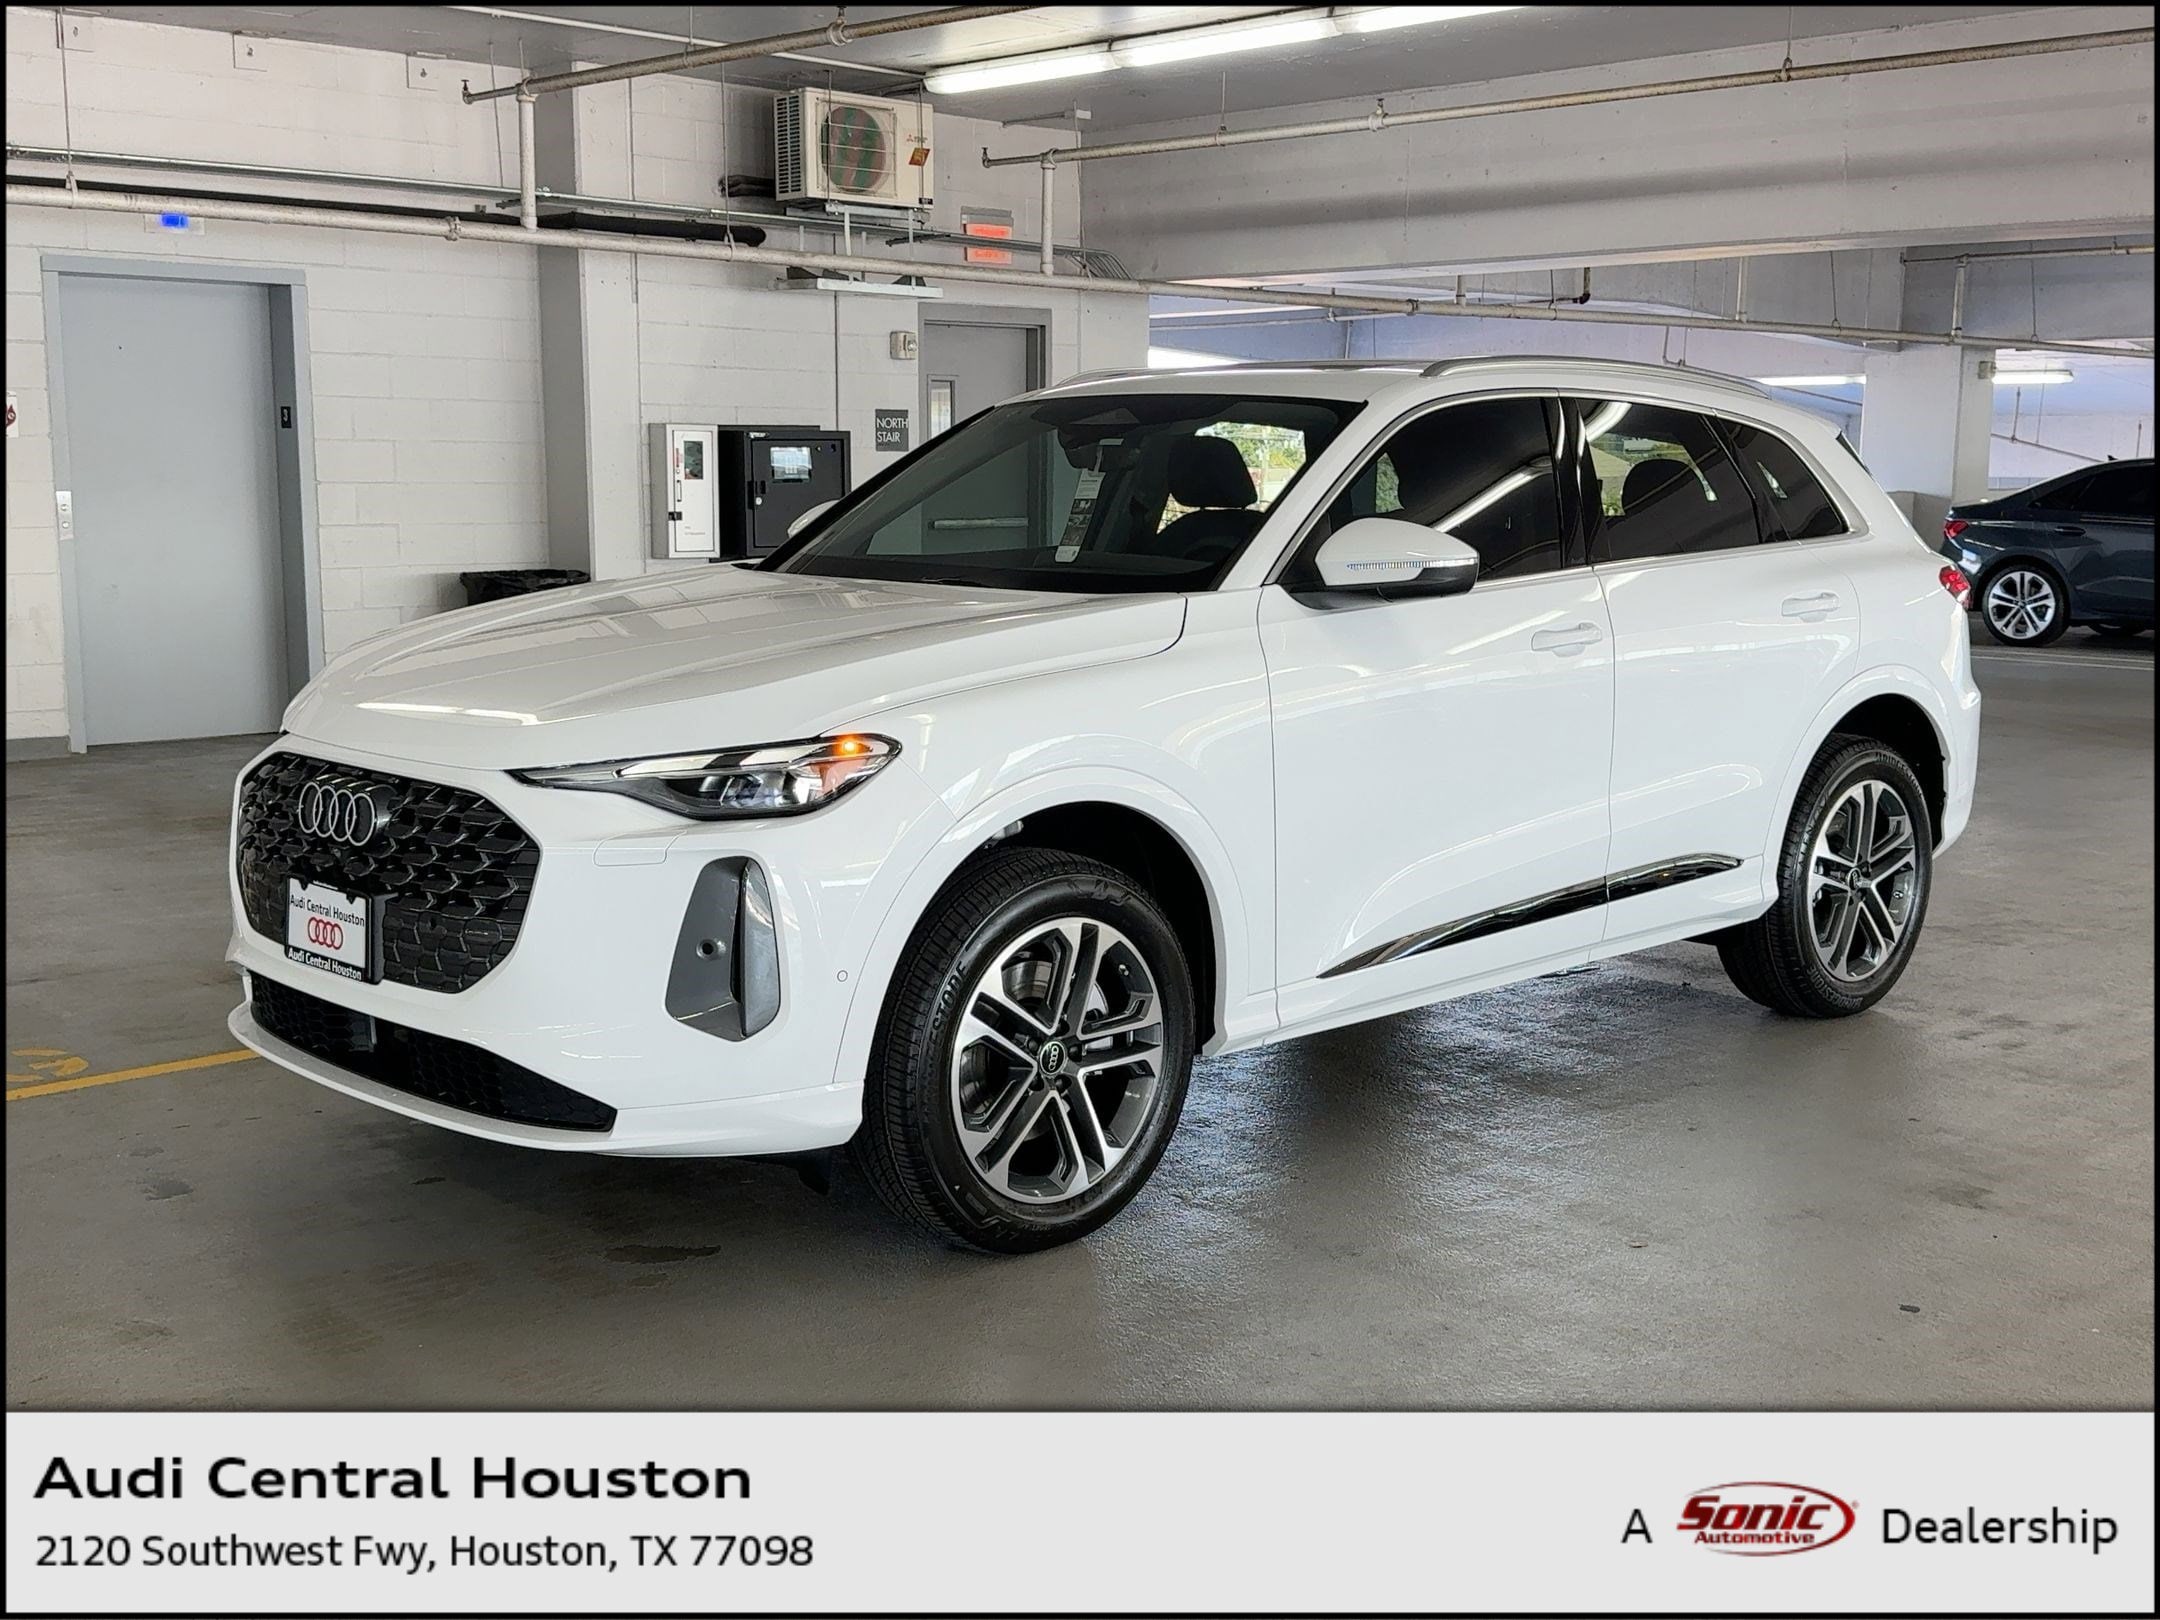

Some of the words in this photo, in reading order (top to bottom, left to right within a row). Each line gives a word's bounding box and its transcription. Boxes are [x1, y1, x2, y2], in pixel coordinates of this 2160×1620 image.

[876, 417, 909, 429] NORTH
[876, 431, 901, 443] STAIR
[290, 894, 305, 910] Audi
[307, 899, 332, 919] Central
[333, 907, 365, 927] Houston
[287, 947, 305, 963] Audi
[305, 953, 331, 971] Central
[332, 962, 362, 981] Houston
